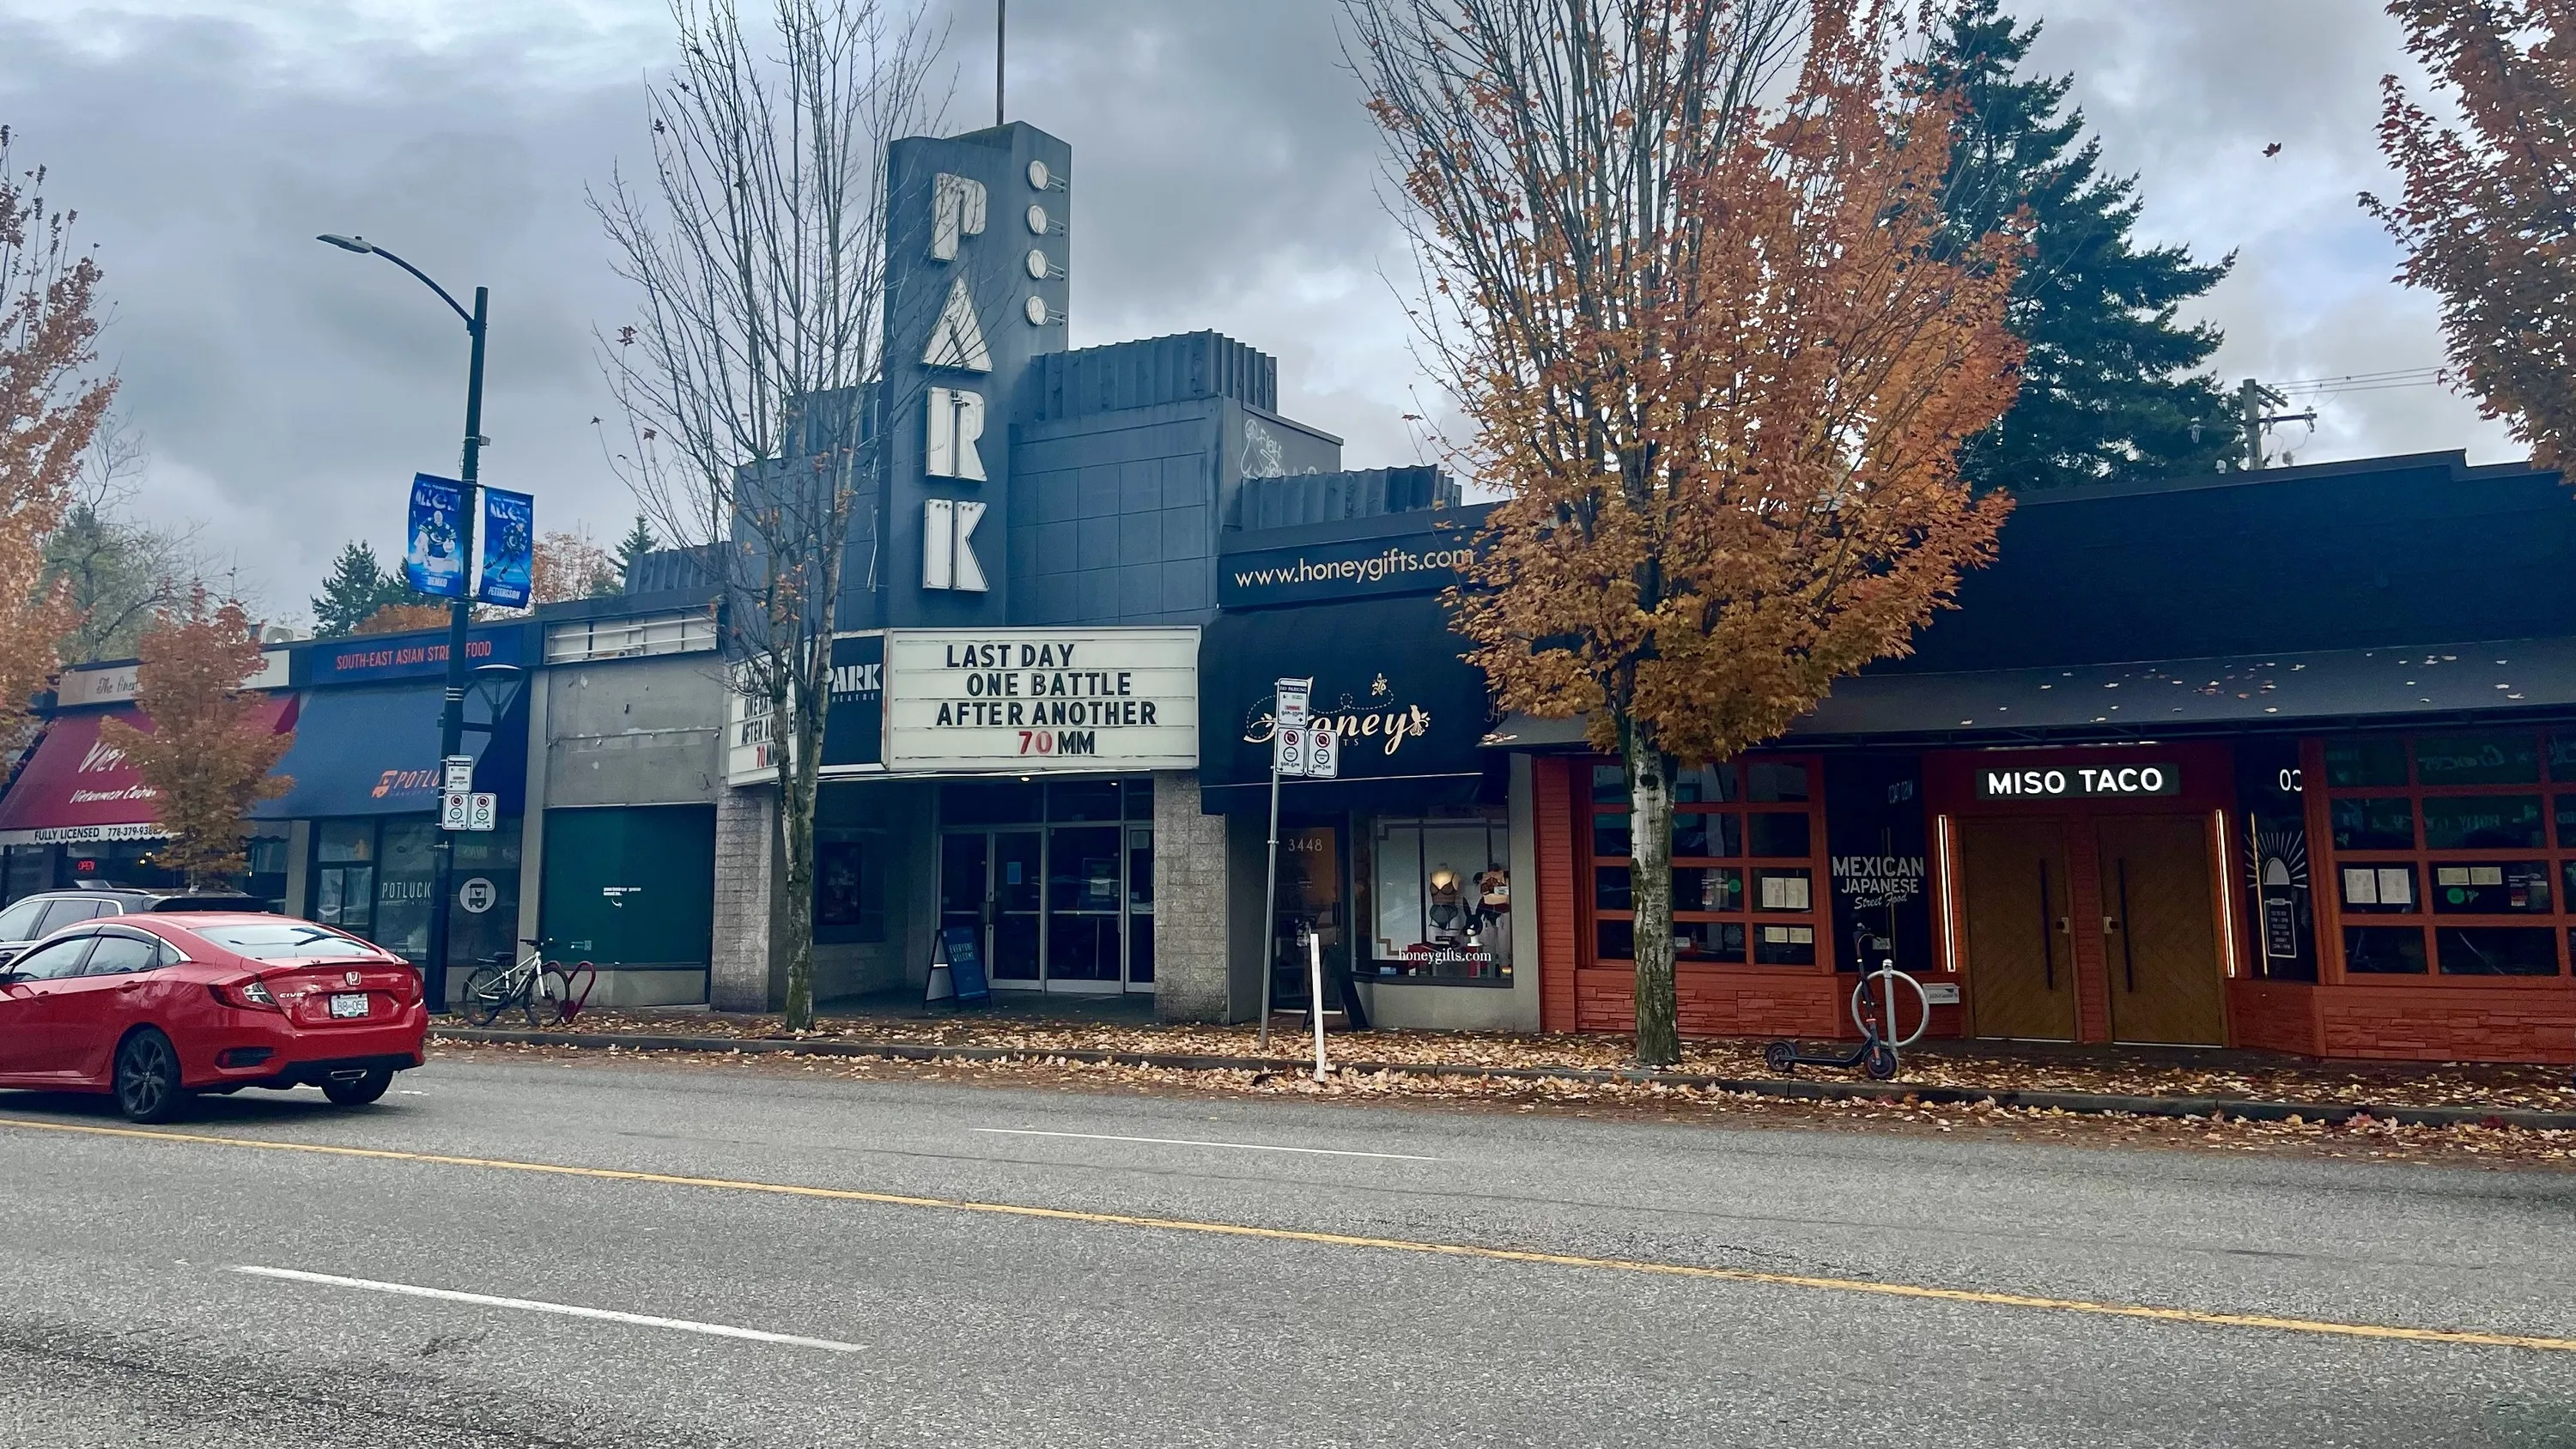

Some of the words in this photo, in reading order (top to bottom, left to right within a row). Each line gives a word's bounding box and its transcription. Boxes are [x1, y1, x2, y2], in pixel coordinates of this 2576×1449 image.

[920, 172, 993, 593] PARK
[1235, 548, 1474, 588] www.honeygifts.com
[337, 651, 393, 670] SOUTH-EAST
[395, 647, 424, 665] ASIAN
[428, 645, 450, 662] STRE
[465, 640, 492, 658] FOOD
[946, 644, 1011, 668] LAST
[1020, 643, 1075, 668] DAY
[96, 677, 113, 694] The
[967, 672, 1018, 697] ONE
[1030, 671, 1132, 696] BATTLE
[832, 692, 876, 703] HEATRE
[936, 701, 1024, 726] AFTER
[1031, 700, 1157, 725] ANOTHER
[393, 769, 440, 789] POTLU
[1987, 771, 2066, 795] MISO
[2078, 767, 2163, 792] TACO
[34, 830, 58, 841] FULLY
[60, 828, 100, 840] LICENSED
[1288, 838, 1323, 852] 3448
[77, 860, 96, 870] OPEN
[1832, 857, 1925, 877] MEXICAN
[381, 881, 432, 900] POTLUCK
[1841, 877, 1919, 894] JAPANESE
[1854, 896, 1882, 911] Street
[1884, 890, 1908, 907] Food
[1398, 947, 1492, 965] honeygifts.com
